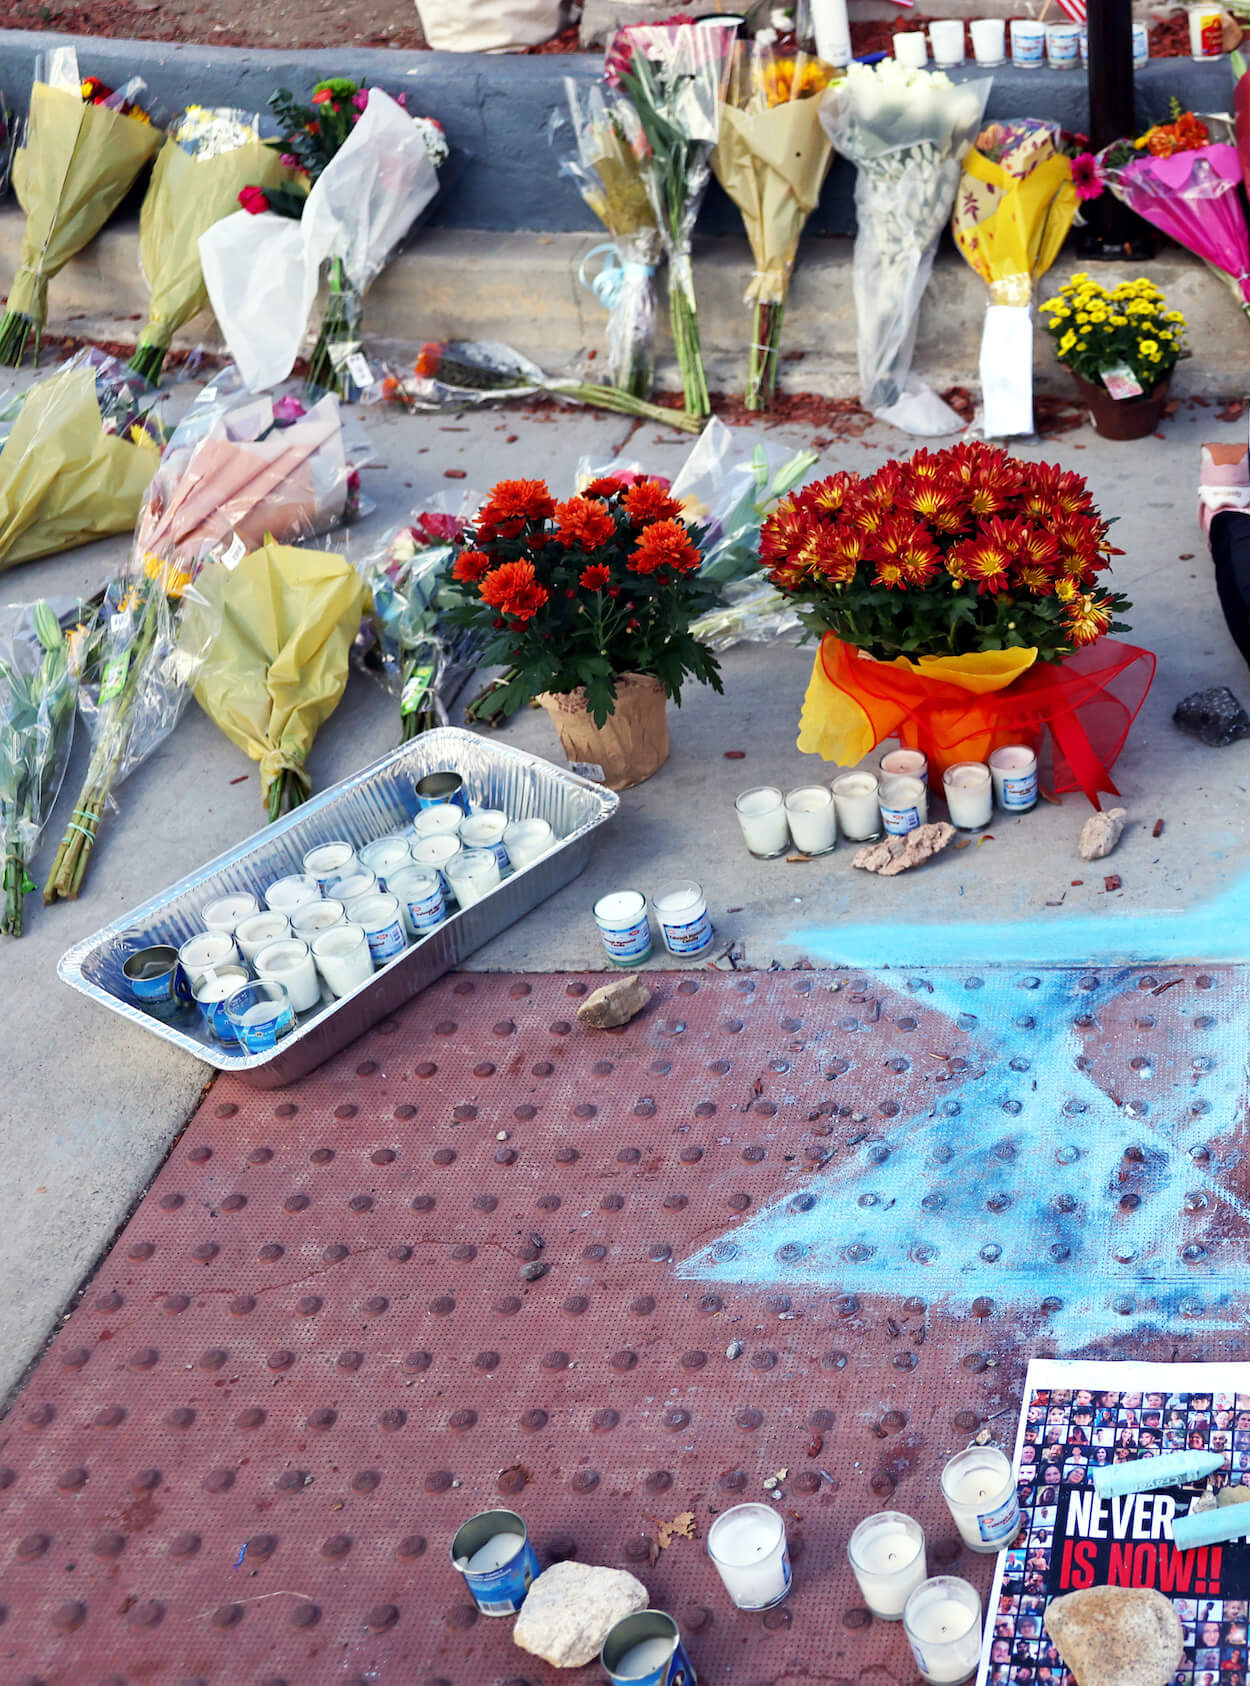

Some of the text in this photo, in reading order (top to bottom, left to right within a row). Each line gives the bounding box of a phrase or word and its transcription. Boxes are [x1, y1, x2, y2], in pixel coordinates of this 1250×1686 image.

[1065, 1490, 1176, 1541] NEVER
[1059, 1539, 1224, 1595] IS NOW!!
